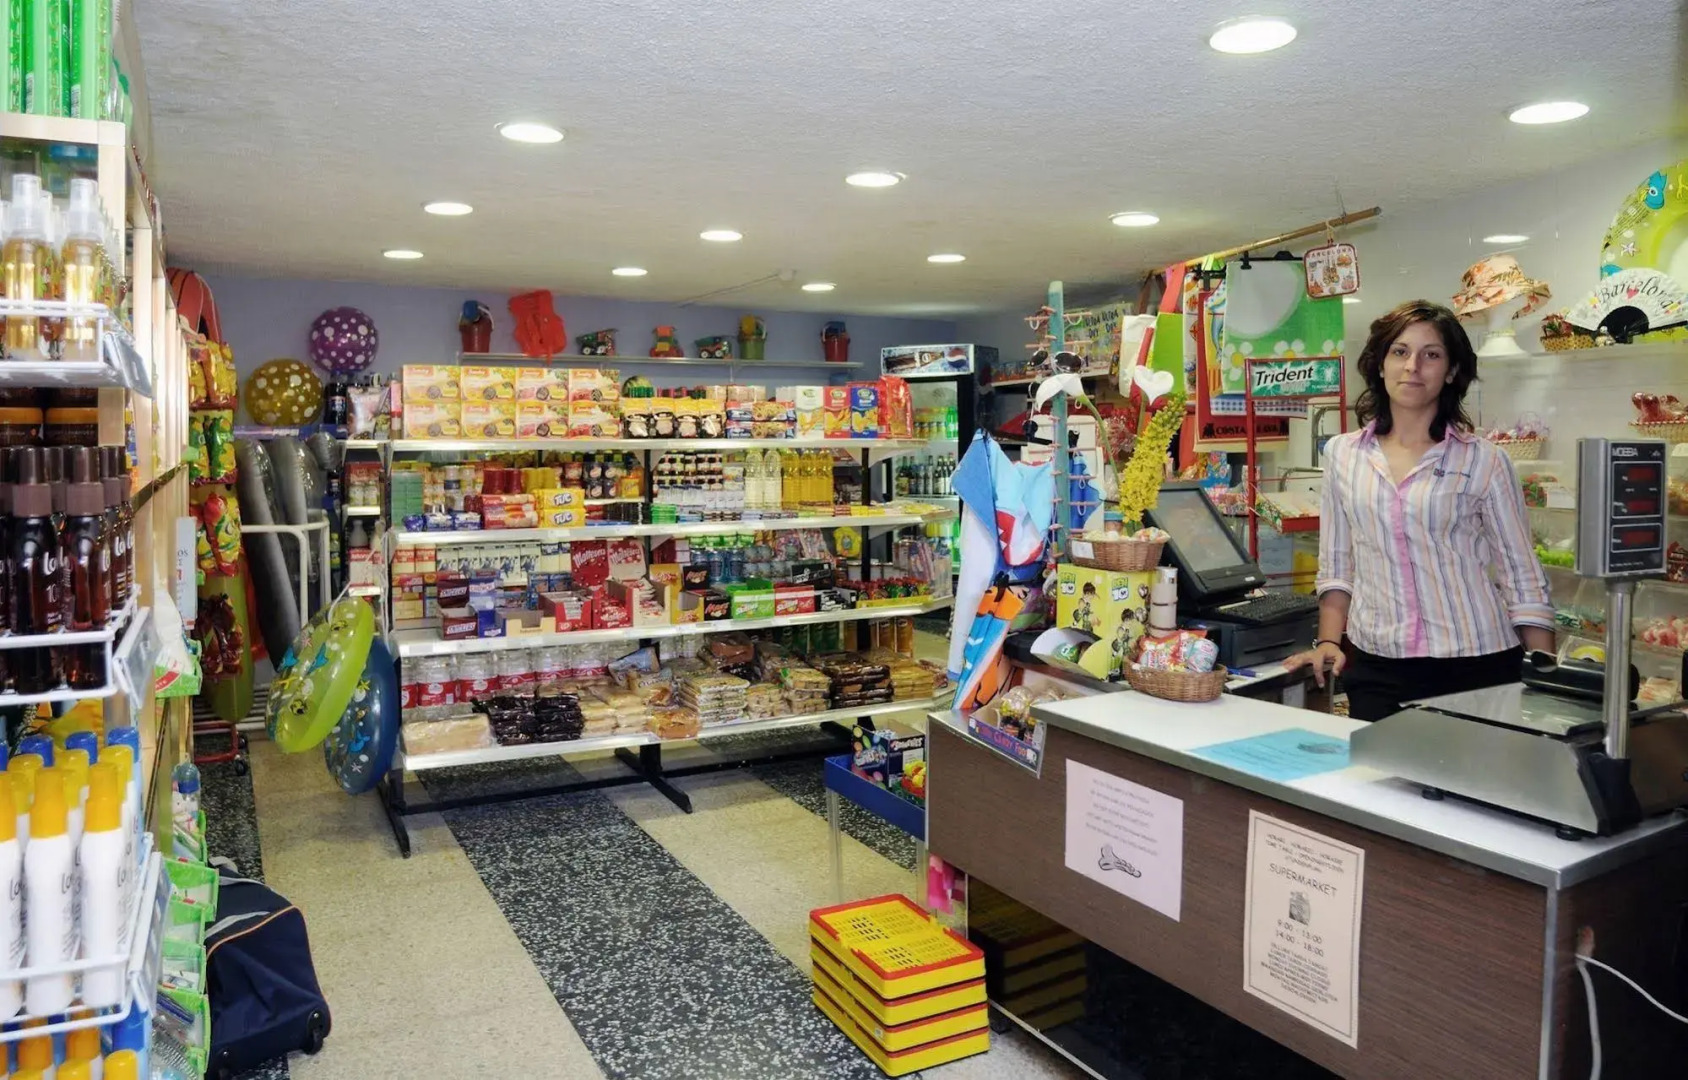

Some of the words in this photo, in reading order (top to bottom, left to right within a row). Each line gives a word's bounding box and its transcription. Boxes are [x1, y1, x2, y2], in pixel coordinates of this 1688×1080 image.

[1599, 276, 1674, 309] Barcelona
[1255, 366, 1314, 387] Trident
[554, 493, 572, 506] TUC
[554, 513, 572, 525] TUC
[573, 548, 606, 568] Maltesers
[610, 548, 641, 564] Maltesers
[440, 586, 467, 598] SNICKERS
[447, 622, 476, 634] SNICKERS
[1269, 862, 1337, 897] SUPERMARKET
